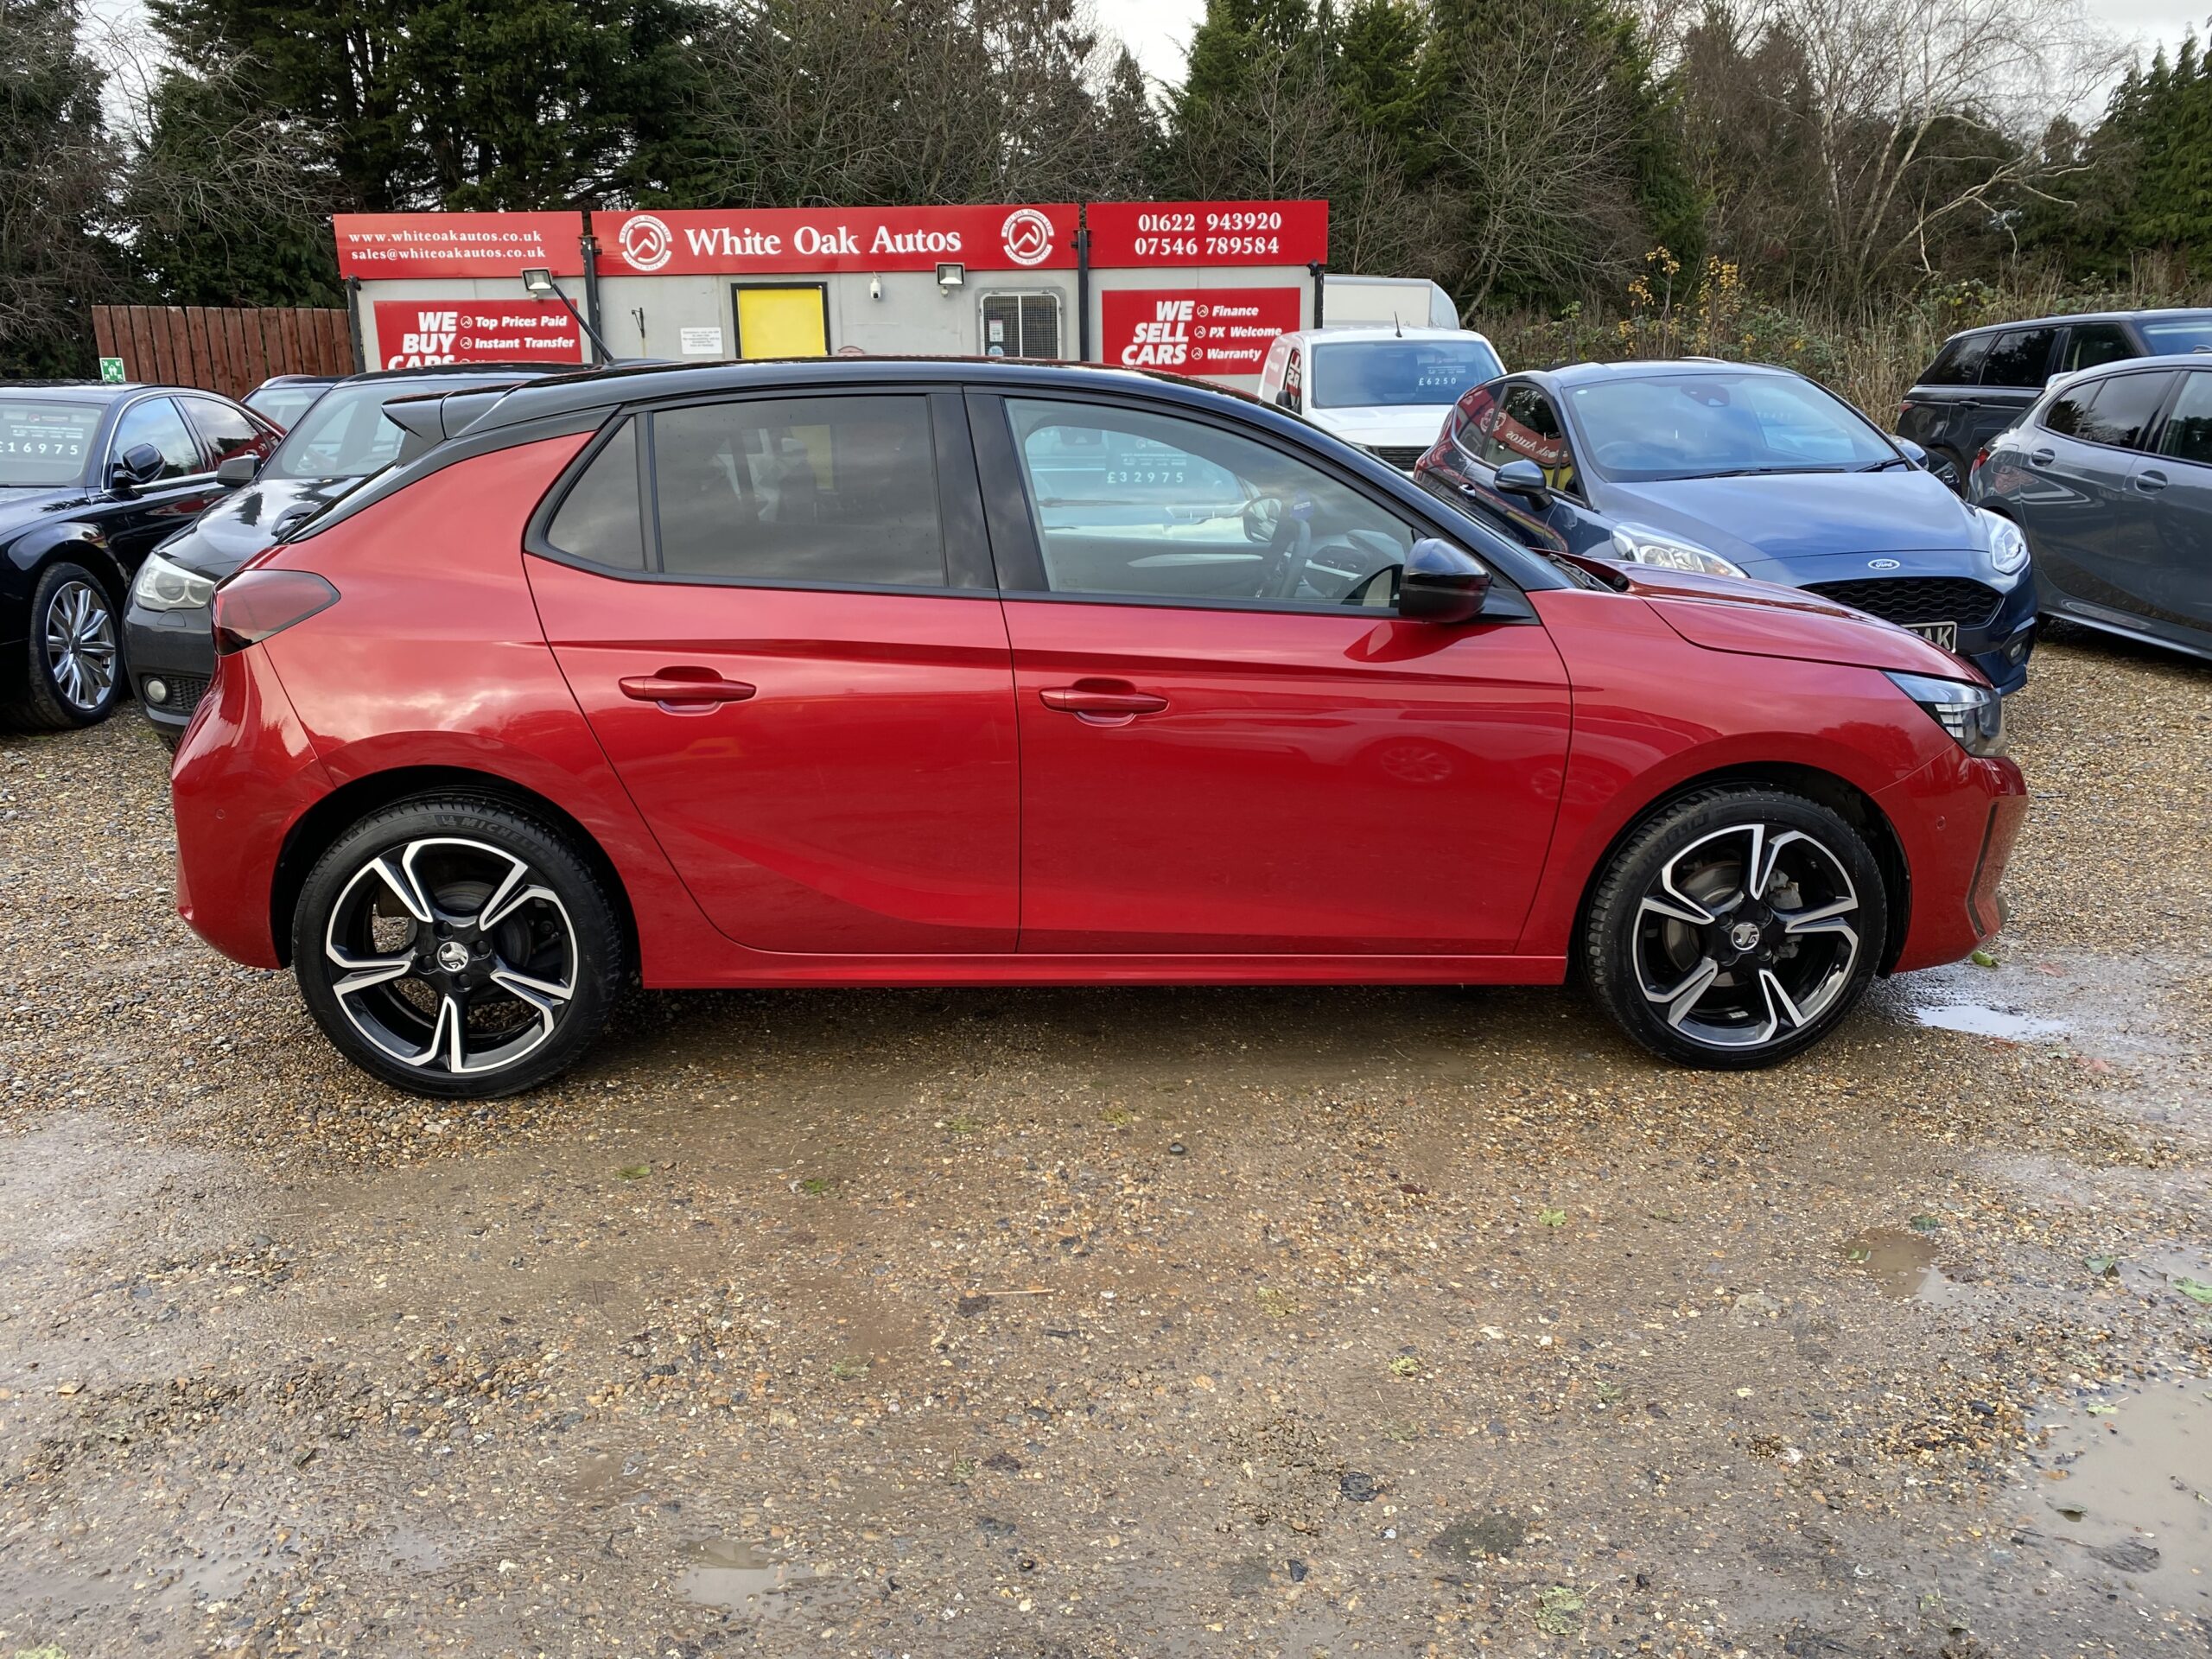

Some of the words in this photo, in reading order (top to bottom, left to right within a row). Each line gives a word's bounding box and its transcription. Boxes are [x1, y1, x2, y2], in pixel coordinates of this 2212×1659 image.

[1138, 213, 1195, 232] 01622
[1206, 212, 1281, 232] 943920
[348, 229, 543, 243] www.whiteoakautos.co.uk
[684, 227, 782, 256] White
[793, 226, 861, 255] Oak
[869, 226, 962, 253] Autos
[1135, 238, 1198, 255] 07546
[1205, 236, 1280, 255] 789584
[351, 246, 546, 260] sales@whiteoakautos.co.uk
[1156, 301, 1195, 321] WE
[1211, 305, 1259, 317] Finance
[417, 311, 458, 333] WE
[475, 316, 499, 330] Top
[501, 316, 537, 327] Prices
[540, 315, 568, 327] Paid
[1133, 322, 1189, 344] SELL
[1209, 327, 1226, 338] PX
[1230, 326, 1282, 338] Welcome
[402, 333, 456, 354] BUY
[474, 338, 520, 349] Instant
[524, 337, 575, 348] Transfer
[1121, 344, 1188, 365] CARS
[1207, 348, 1262, 362] Warranty
[1107, 471, 1184, 484] £32975
[461, 817, 551, 860] MICHELIN
